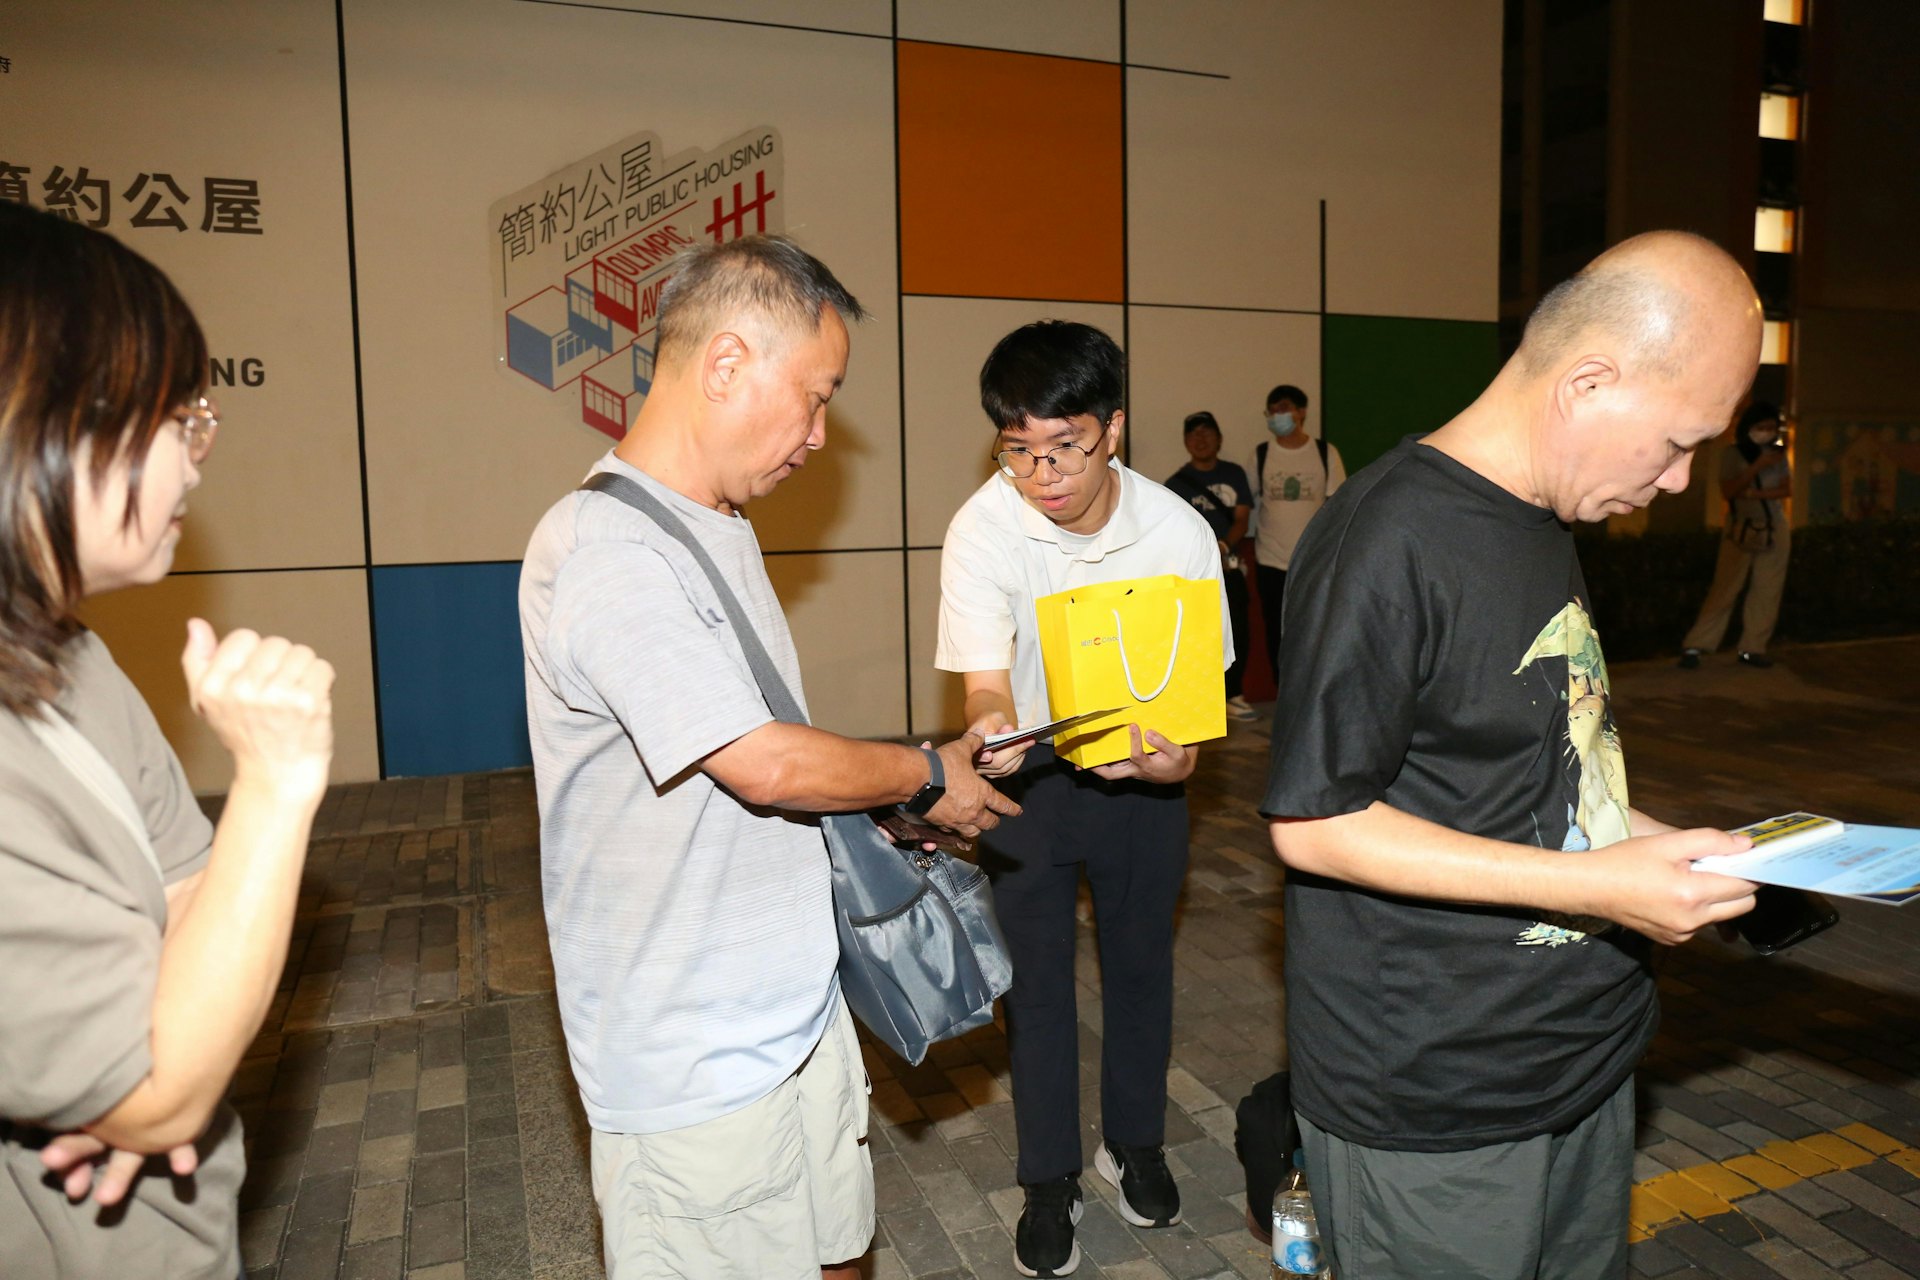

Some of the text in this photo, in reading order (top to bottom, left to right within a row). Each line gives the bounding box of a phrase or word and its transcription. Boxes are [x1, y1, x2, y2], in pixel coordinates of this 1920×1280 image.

[498, 141, 672, 276] 簡約公屋
[565, 134, 774, 262] LIGHT PUBLIC HOUSING
[607, 225, 695, 276] OLYMPIC
